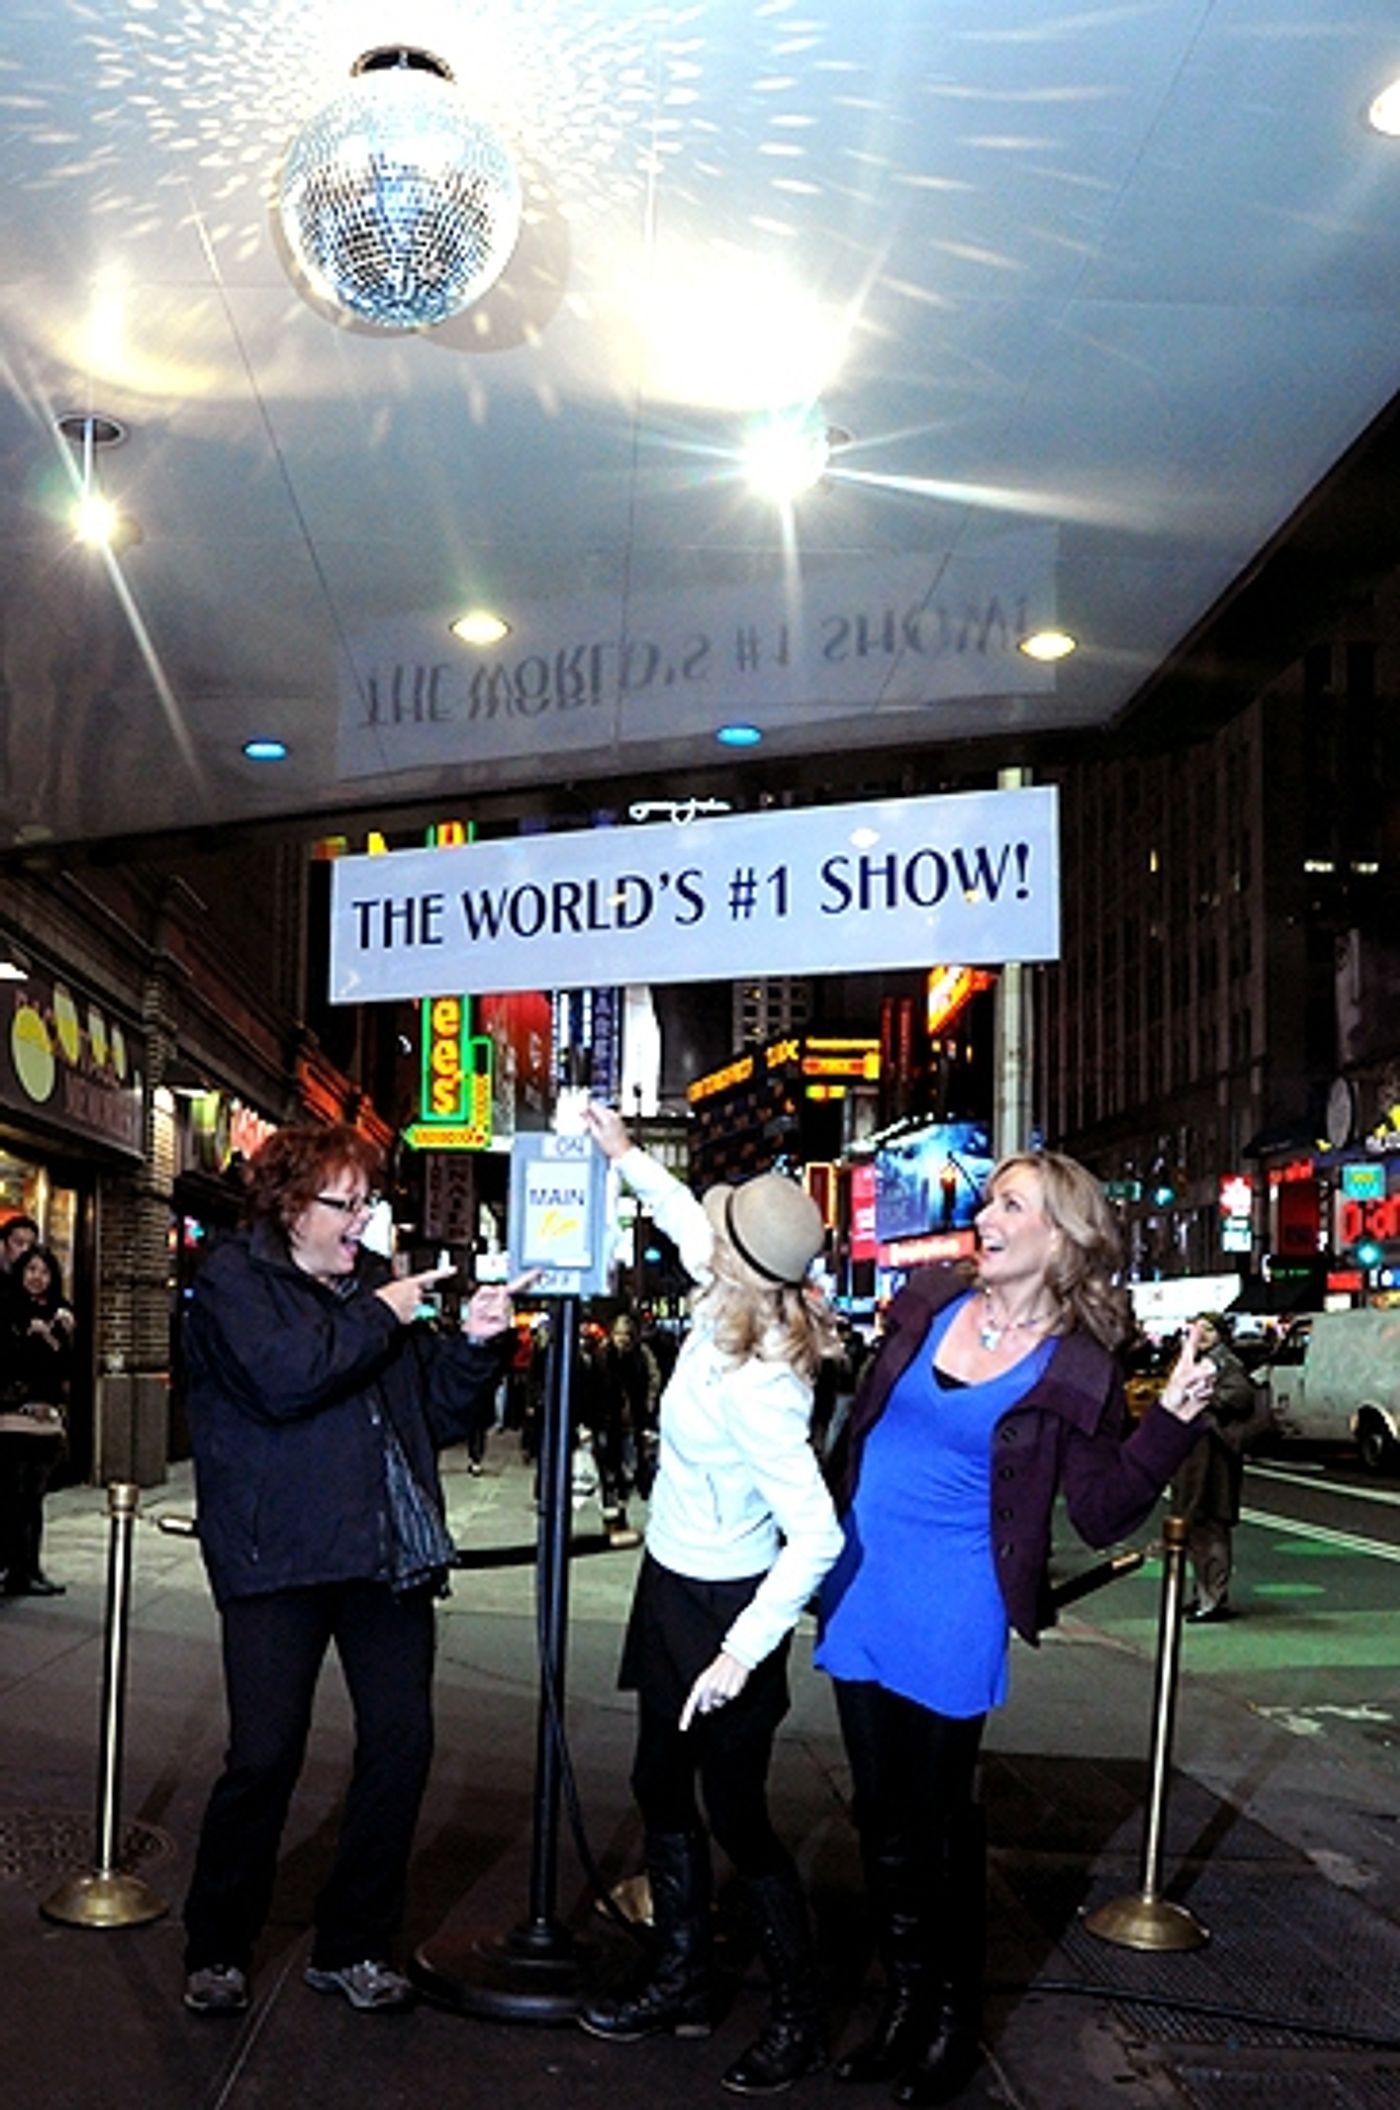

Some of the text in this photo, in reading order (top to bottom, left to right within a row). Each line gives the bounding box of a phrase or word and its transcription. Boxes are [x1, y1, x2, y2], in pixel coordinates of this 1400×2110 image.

[352, 842, 1029, 949] THE WORLD'S #1 SHOW!
[529, 1188, 585, 1206] MAIN
